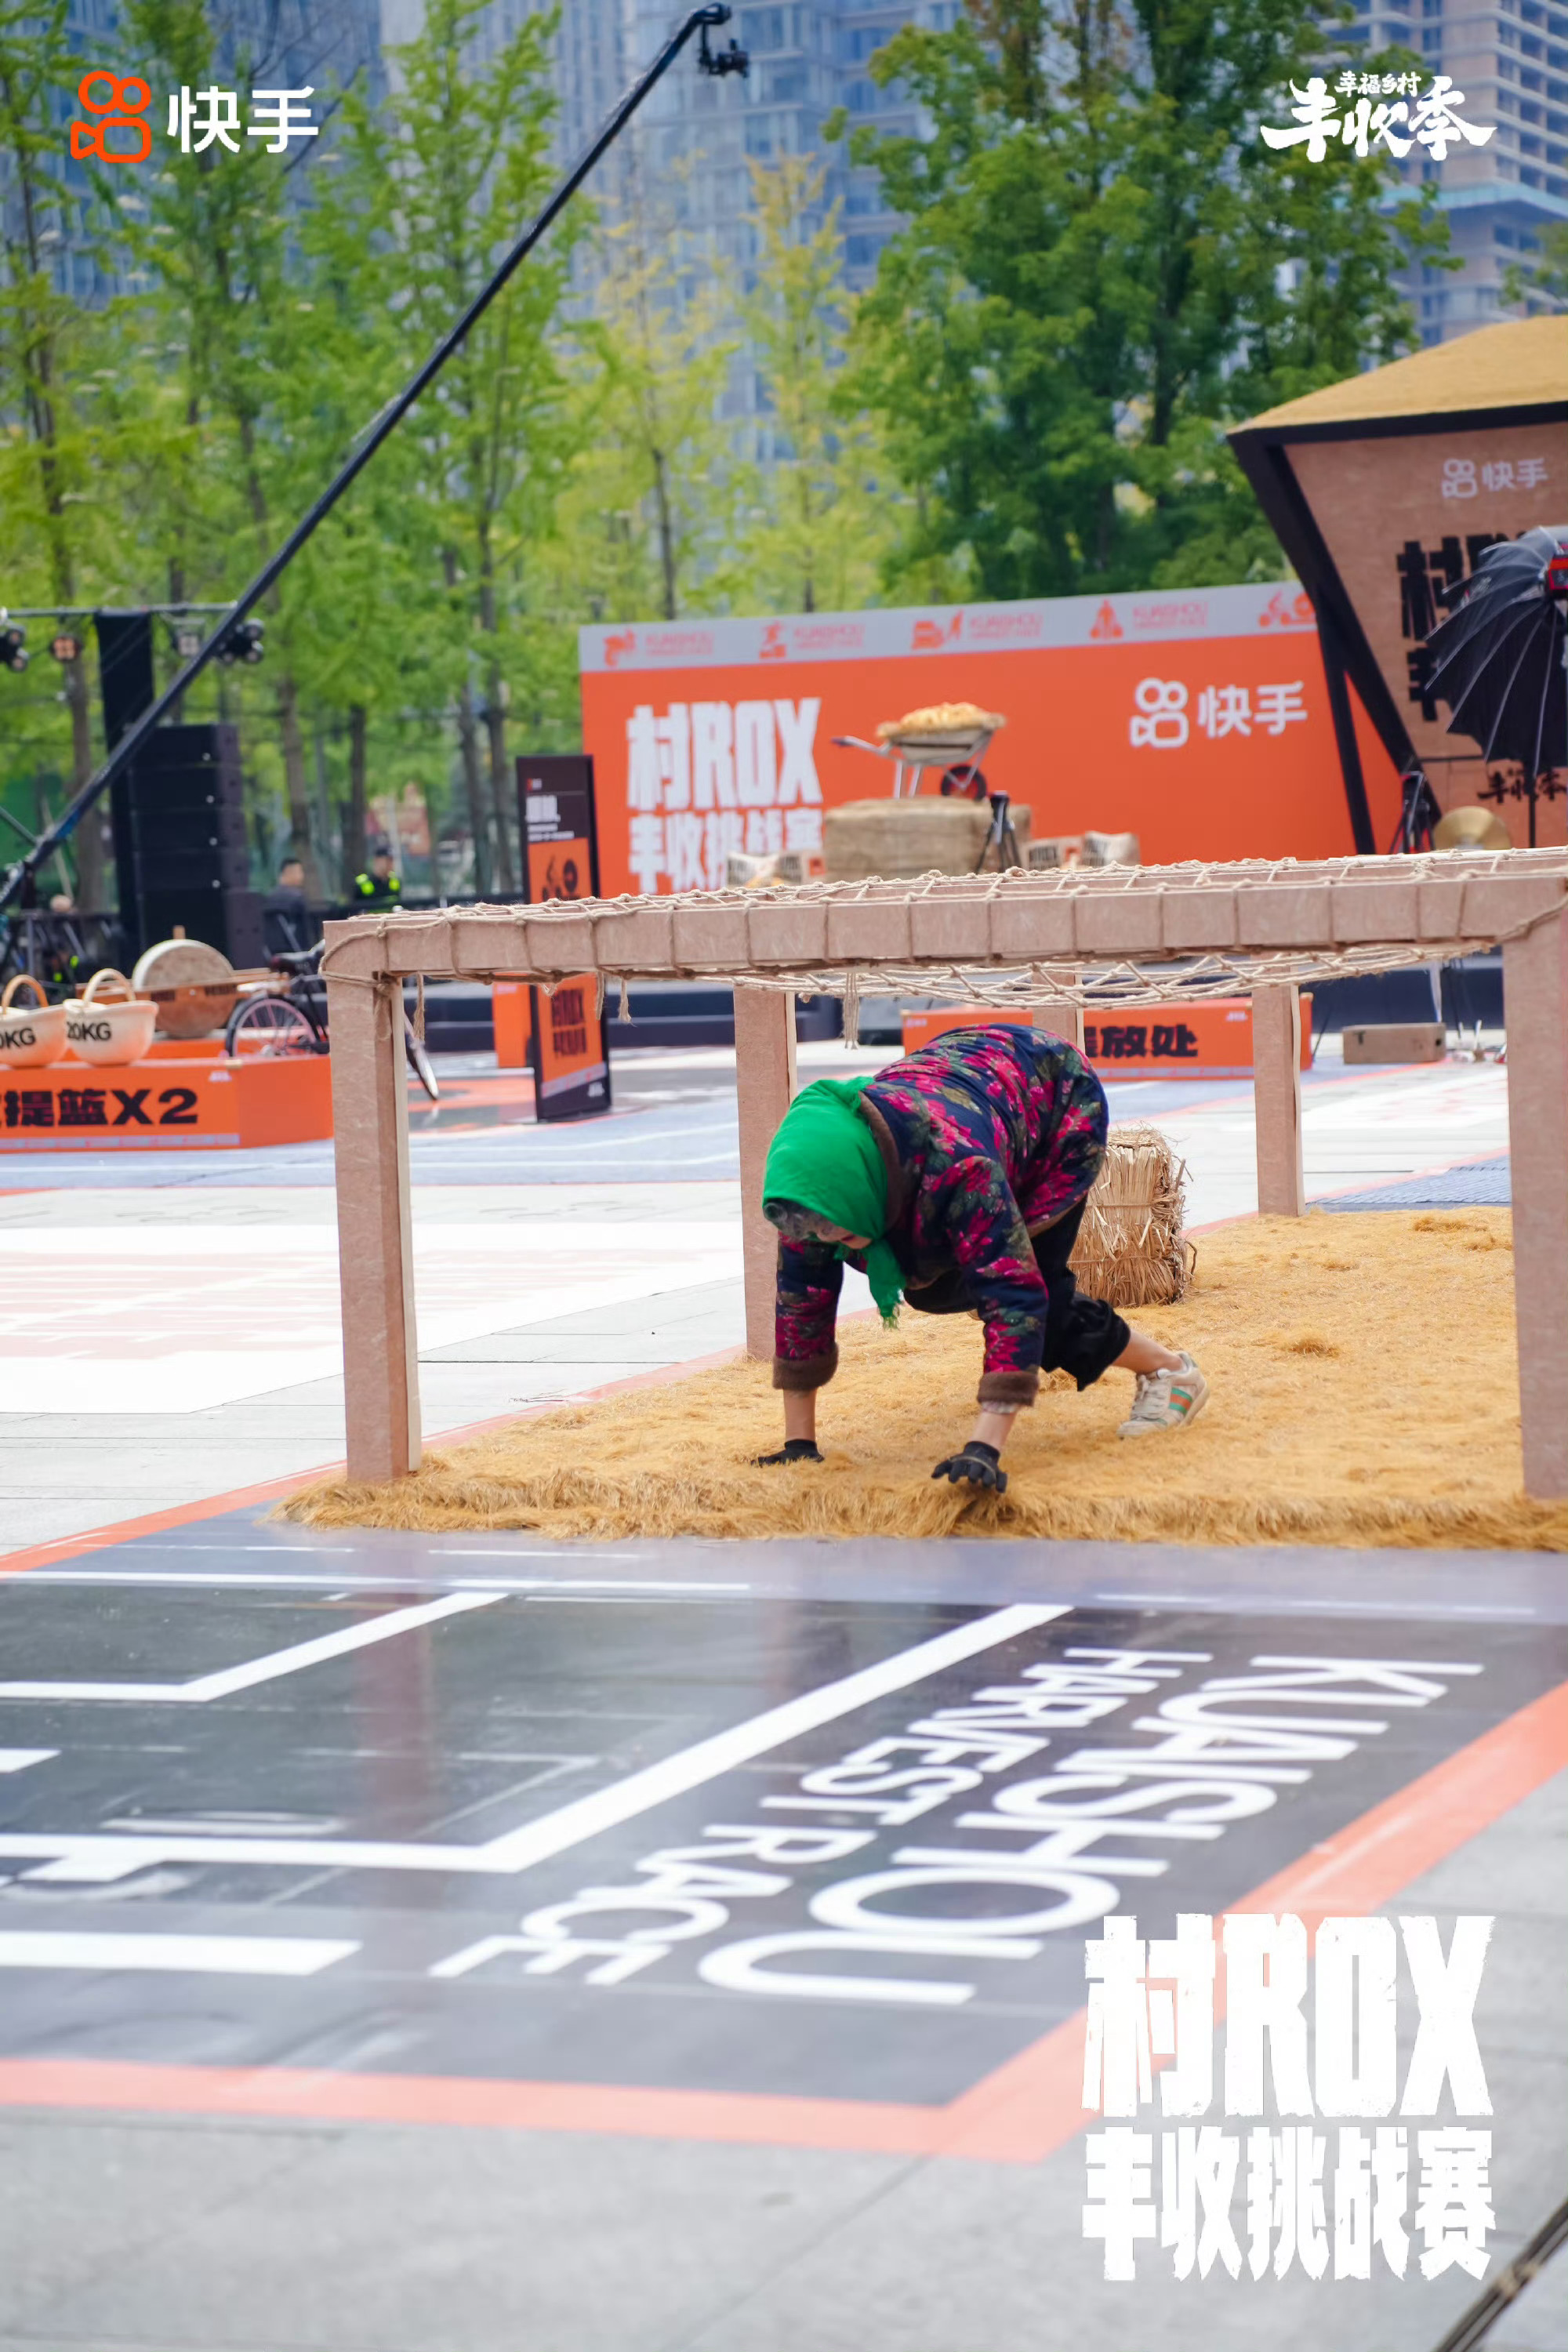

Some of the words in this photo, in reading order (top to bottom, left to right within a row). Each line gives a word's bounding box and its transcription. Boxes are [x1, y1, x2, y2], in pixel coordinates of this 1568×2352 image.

[1481, 457, 1548, 492] 快手
[626, 698, 822, 811] 村ROX
[1197, 681, 1308, 739] 快手
[0, 1087, 198, 1127] 提篮X2
[759, 1649, 1214, 1826] HARVEST
[696, 1657, 1483, 2004] KUAISHOU
[427, 1824, 878, 1985] RACE
